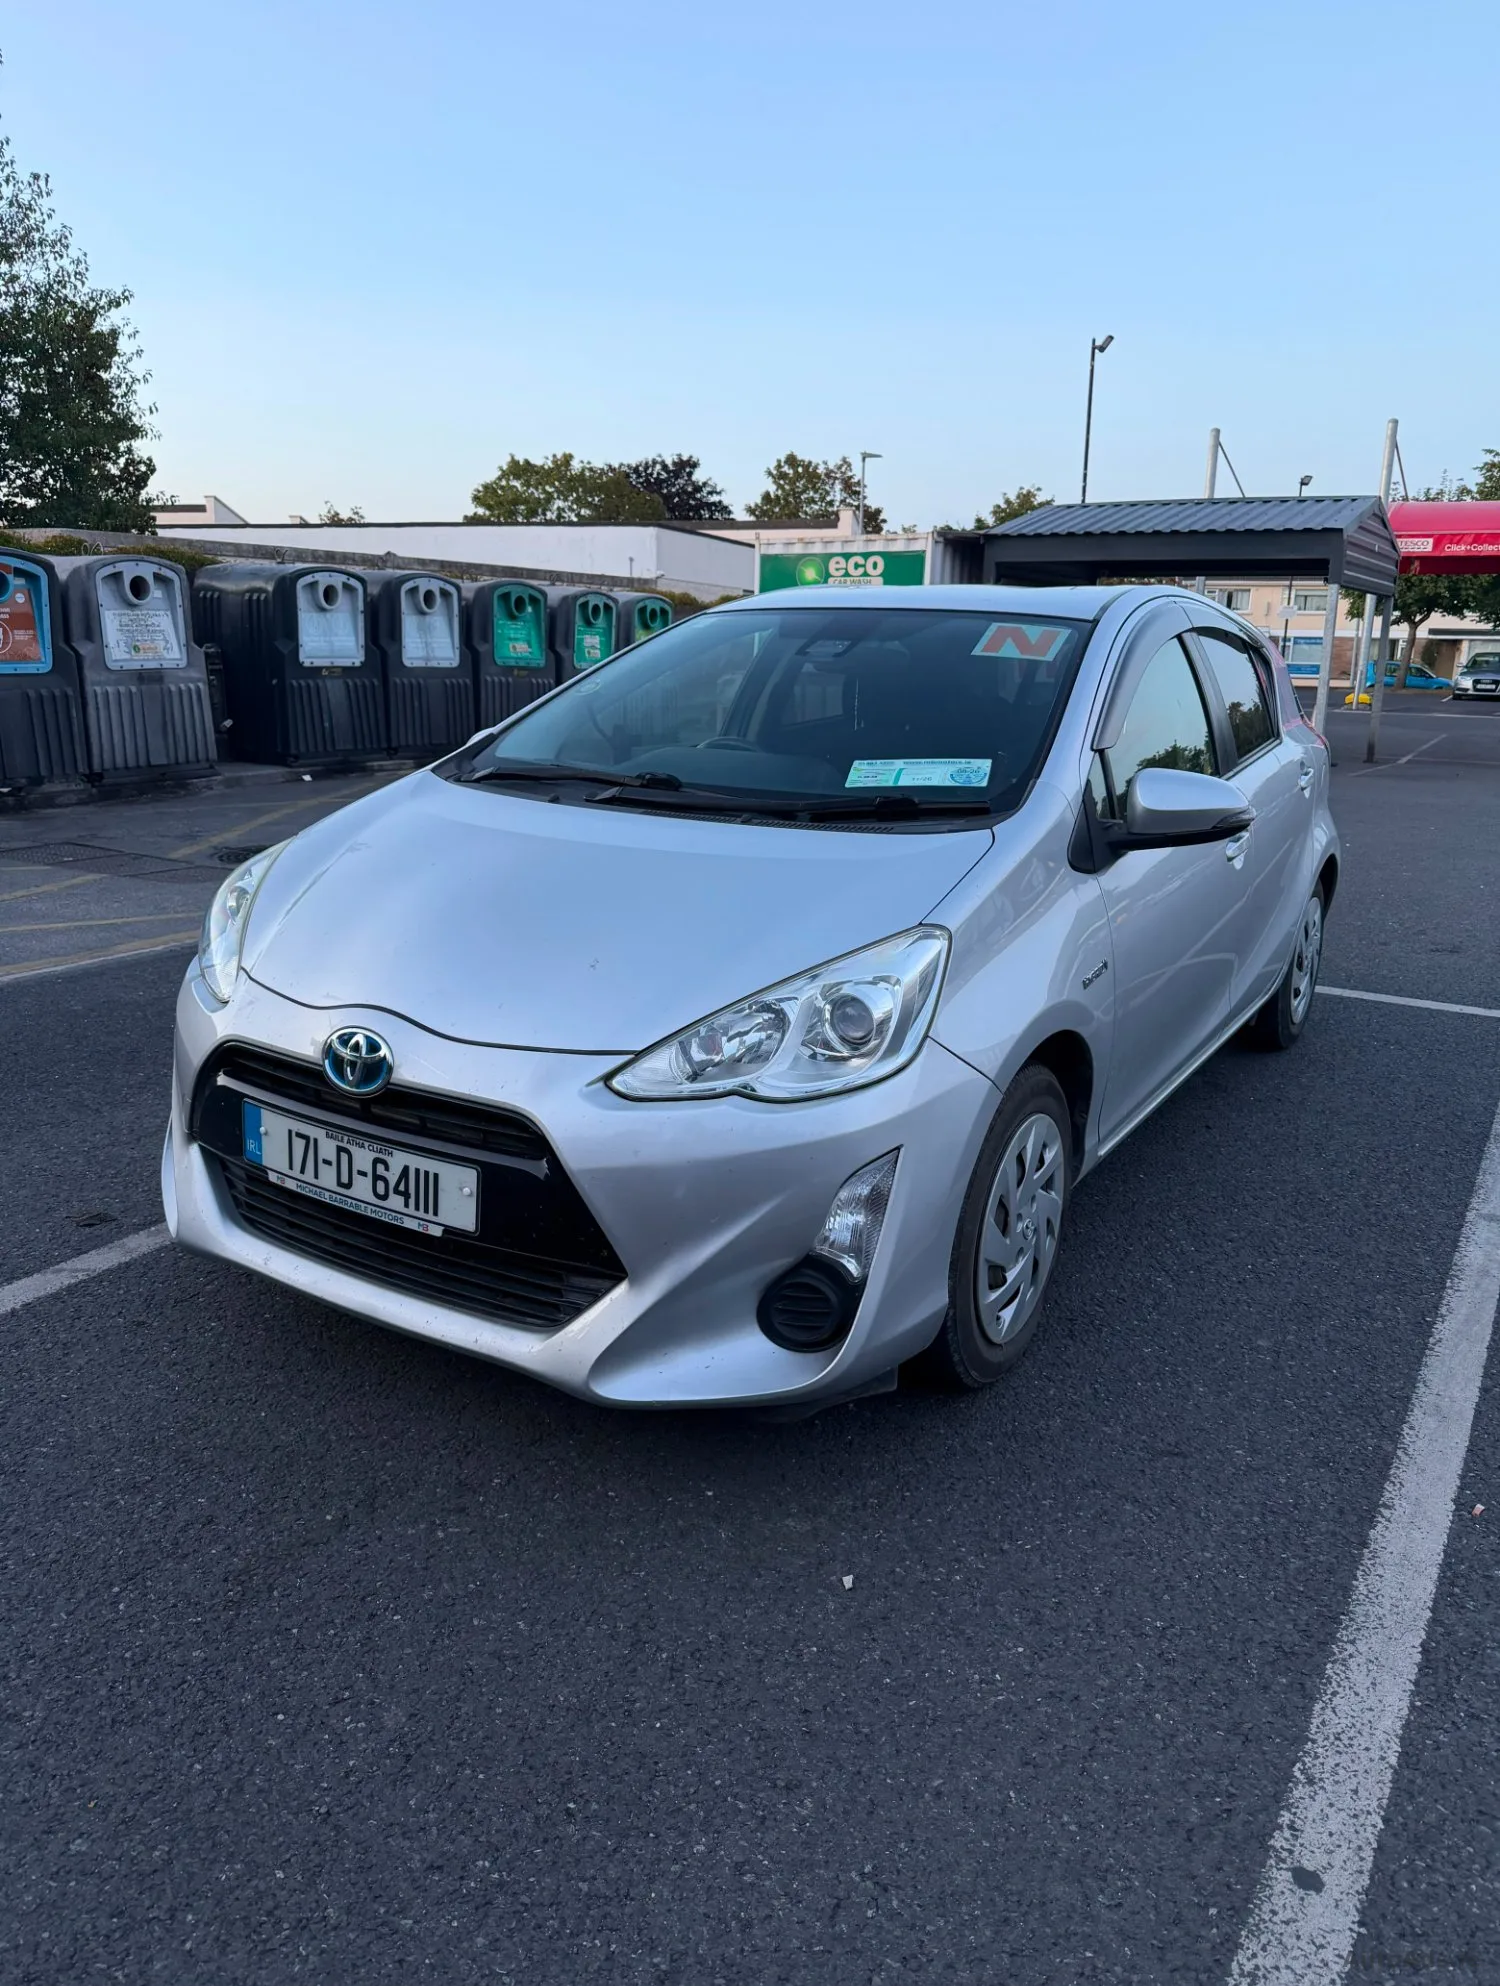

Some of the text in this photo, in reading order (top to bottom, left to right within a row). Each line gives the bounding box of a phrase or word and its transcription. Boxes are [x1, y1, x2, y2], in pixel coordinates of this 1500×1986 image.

[828, 555, 885, 577] eco
[981, 625, 1062, 657] N
[247, 1138, 262, 1155] IRL
[325, 1131, 345, 1143] BAILE
[367, 1144, 394, 1157] CLIATH
[287, 1128, 440, 1217] 171-D-64111
[296, 1183, 328, 1200] MICHAEL
[328, 1195, 370, 1214] BARRABLE
[370, 1208, 405, 1225] MOTORS
